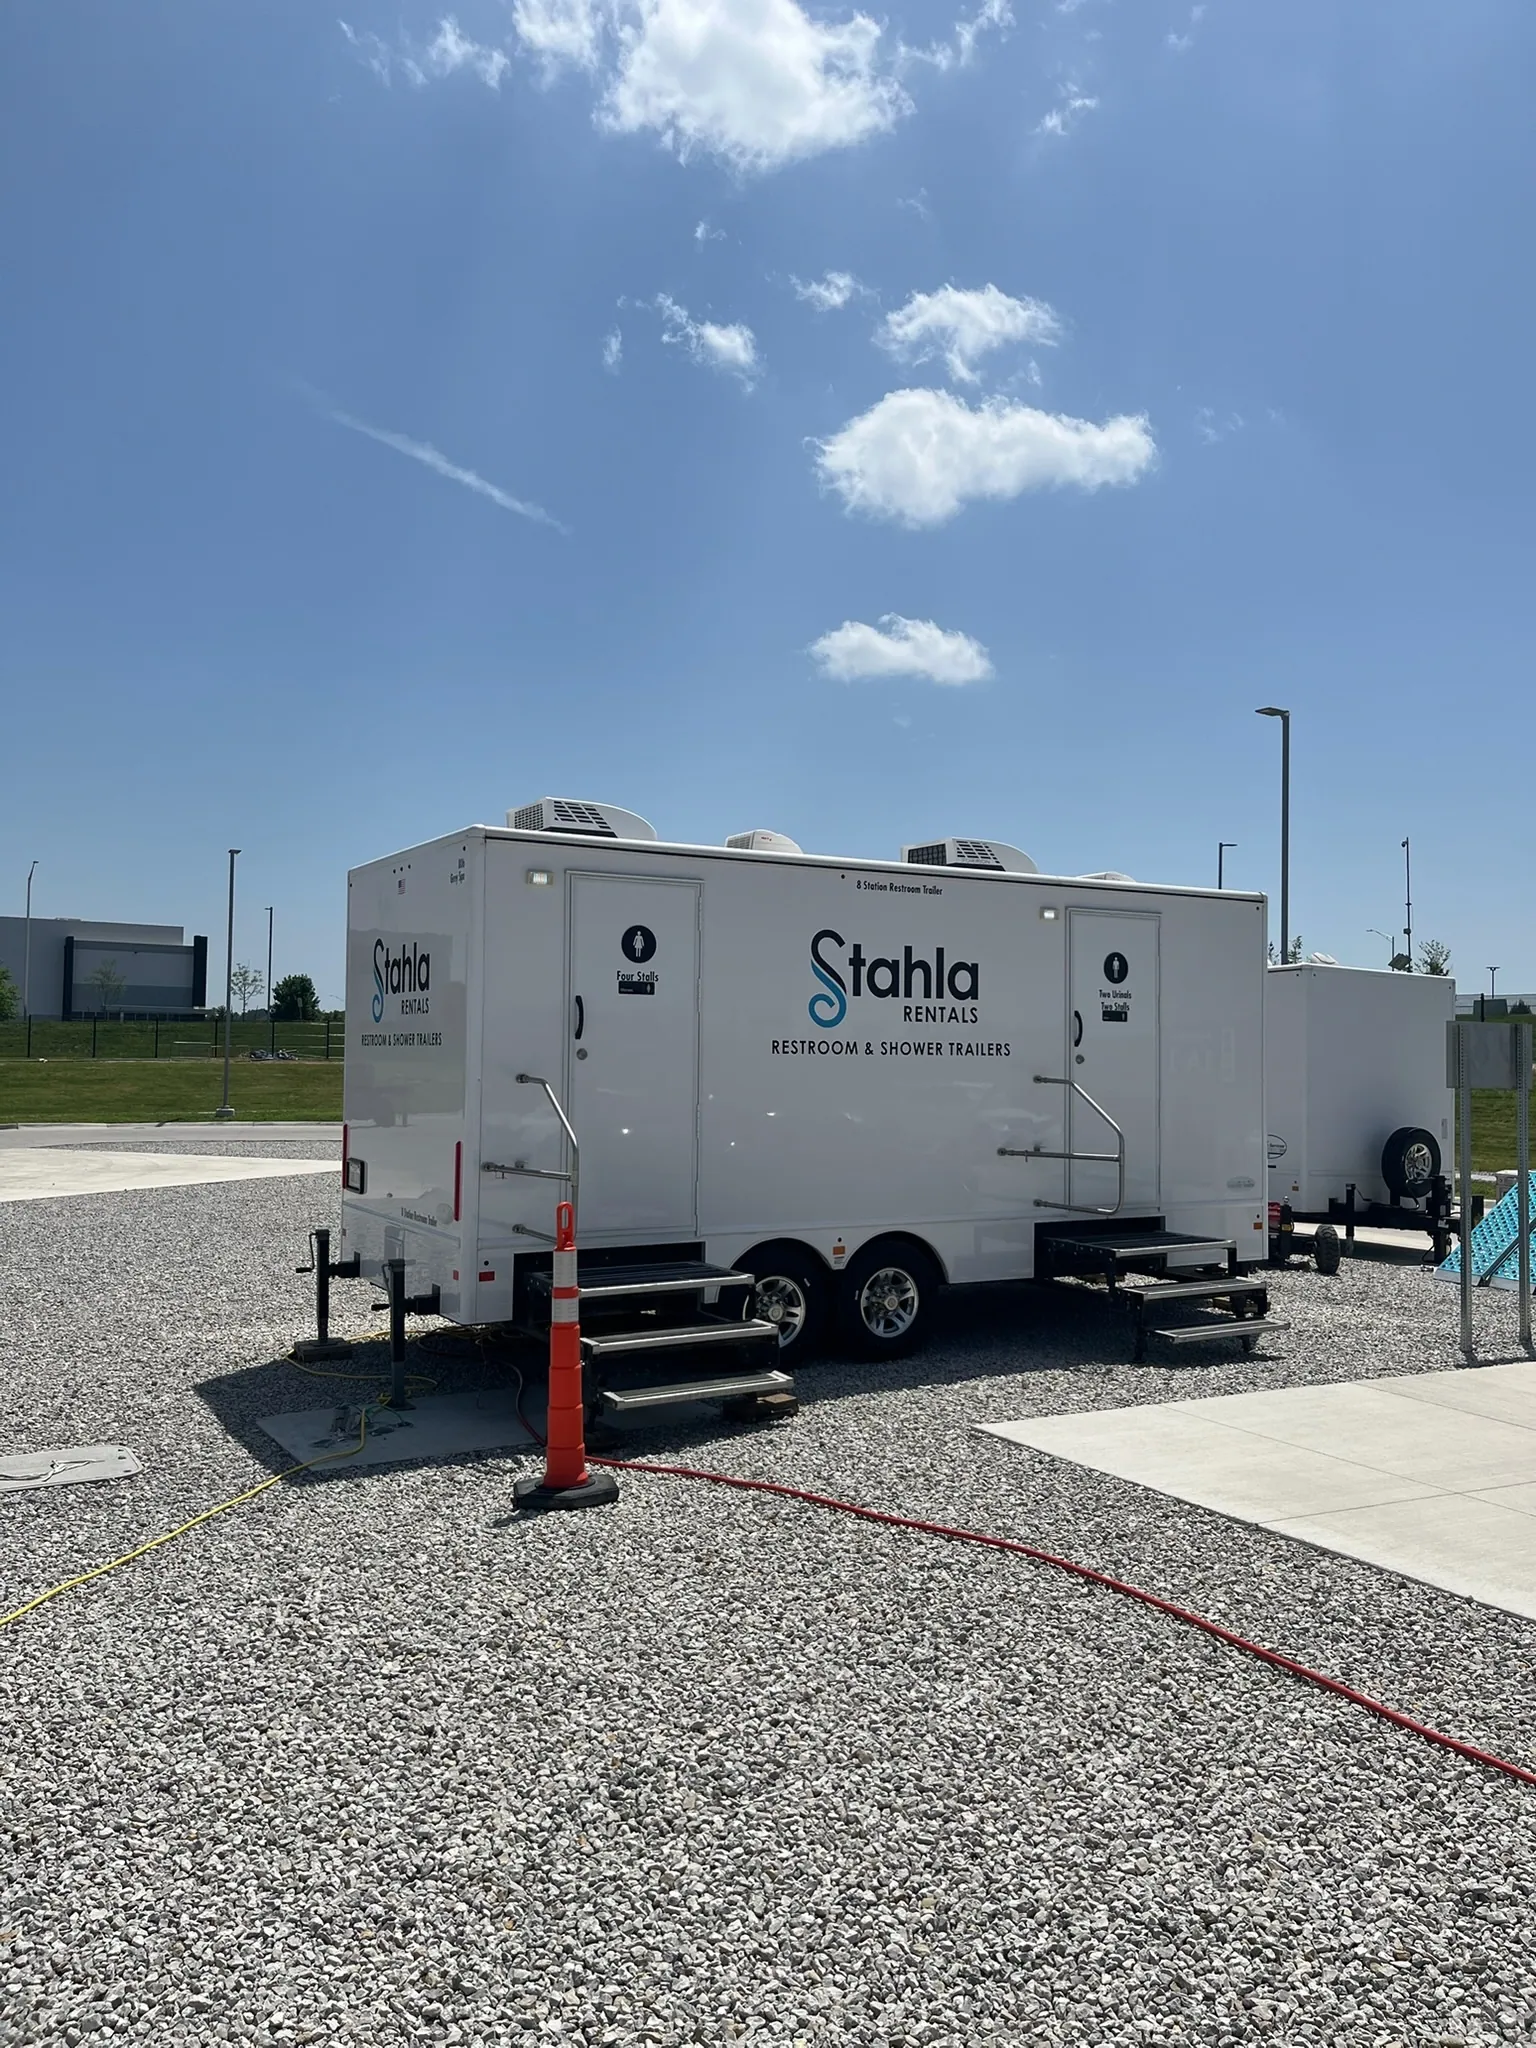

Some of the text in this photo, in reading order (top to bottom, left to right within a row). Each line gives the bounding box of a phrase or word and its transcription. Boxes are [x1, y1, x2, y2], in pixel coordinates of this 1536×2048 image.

[856, 880, 943, 895] 8 Station Restroom Trailer
[372, 938, 430, 1023] Stahla
[616, 970, 659, 982] Four Stalls
[808, 929, 979, 1028] Stahla
[1099, 989, 1132, 999] Two Urinals
[401, 998, 430, 1015] RENTALS
[903, 1005, 978, 1023] RENTALS
[1101, 1001, 1130, 1011] Two Stalls
[361, 1032, 442, 1046] RESTROOM & SHOWER TRAILERS
[771, 1039, 1011, 1056] RESTROOM & SHOWER TRAILERS
